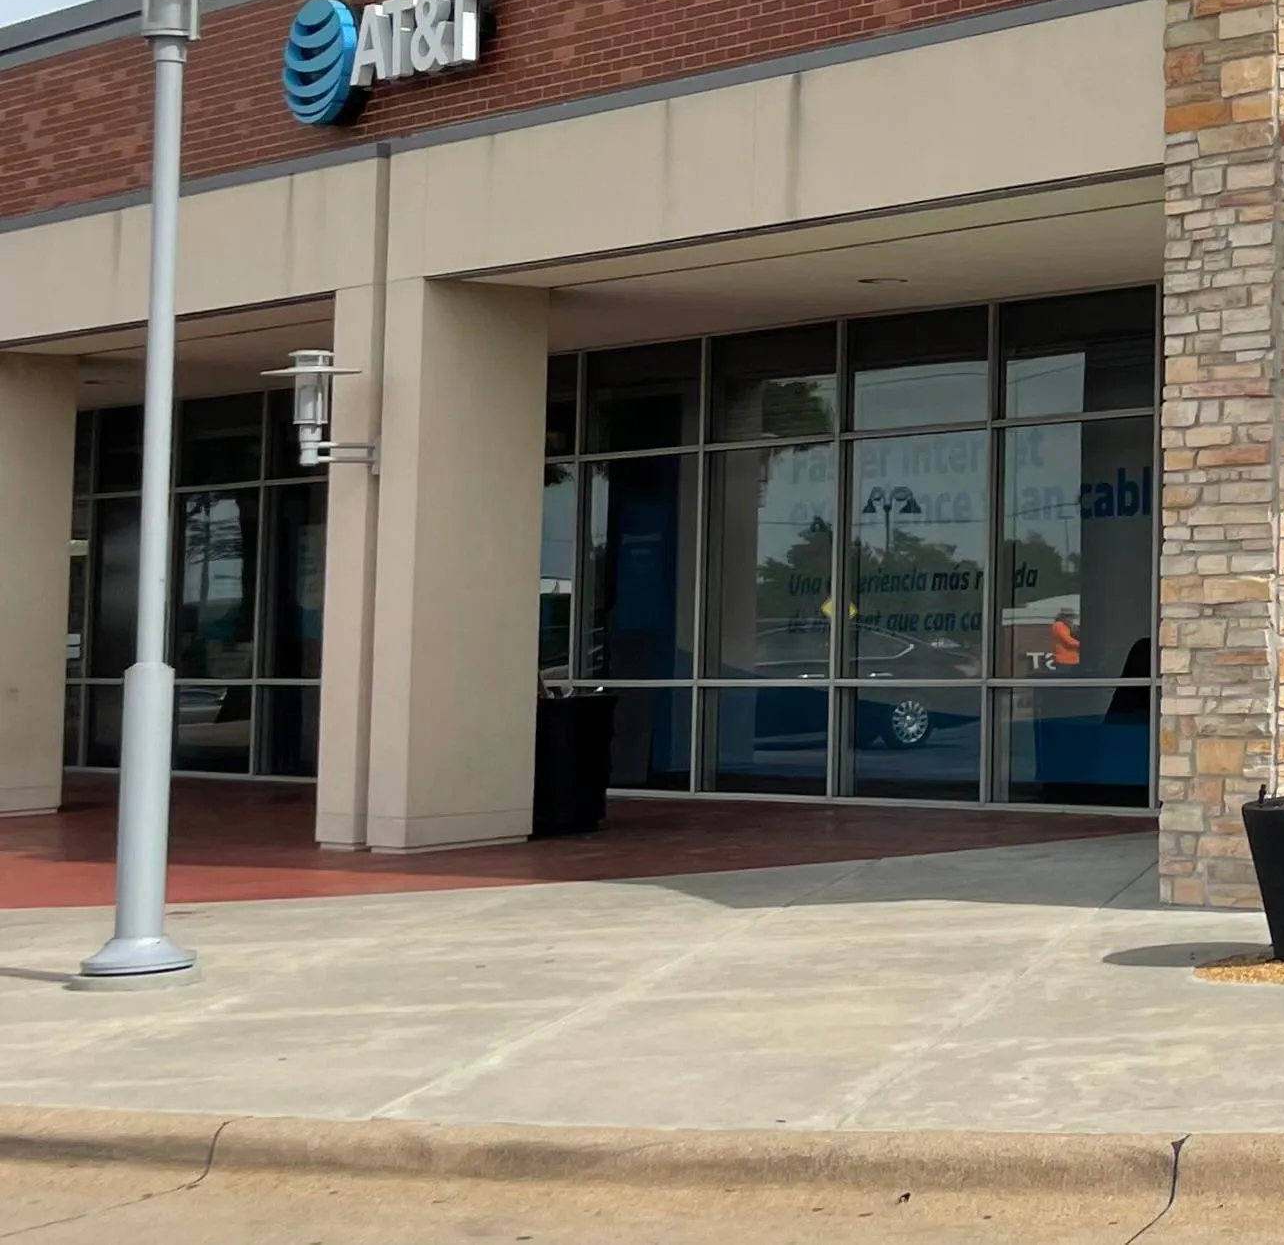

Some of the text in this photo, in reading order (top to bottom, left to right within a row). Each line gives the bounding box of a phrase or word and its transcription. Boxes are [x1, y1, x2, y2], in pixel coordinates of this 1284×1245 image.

[1076, 466, 1151, 519] cabl
[788, 561, 1038, 596] Una eriencia más rda
